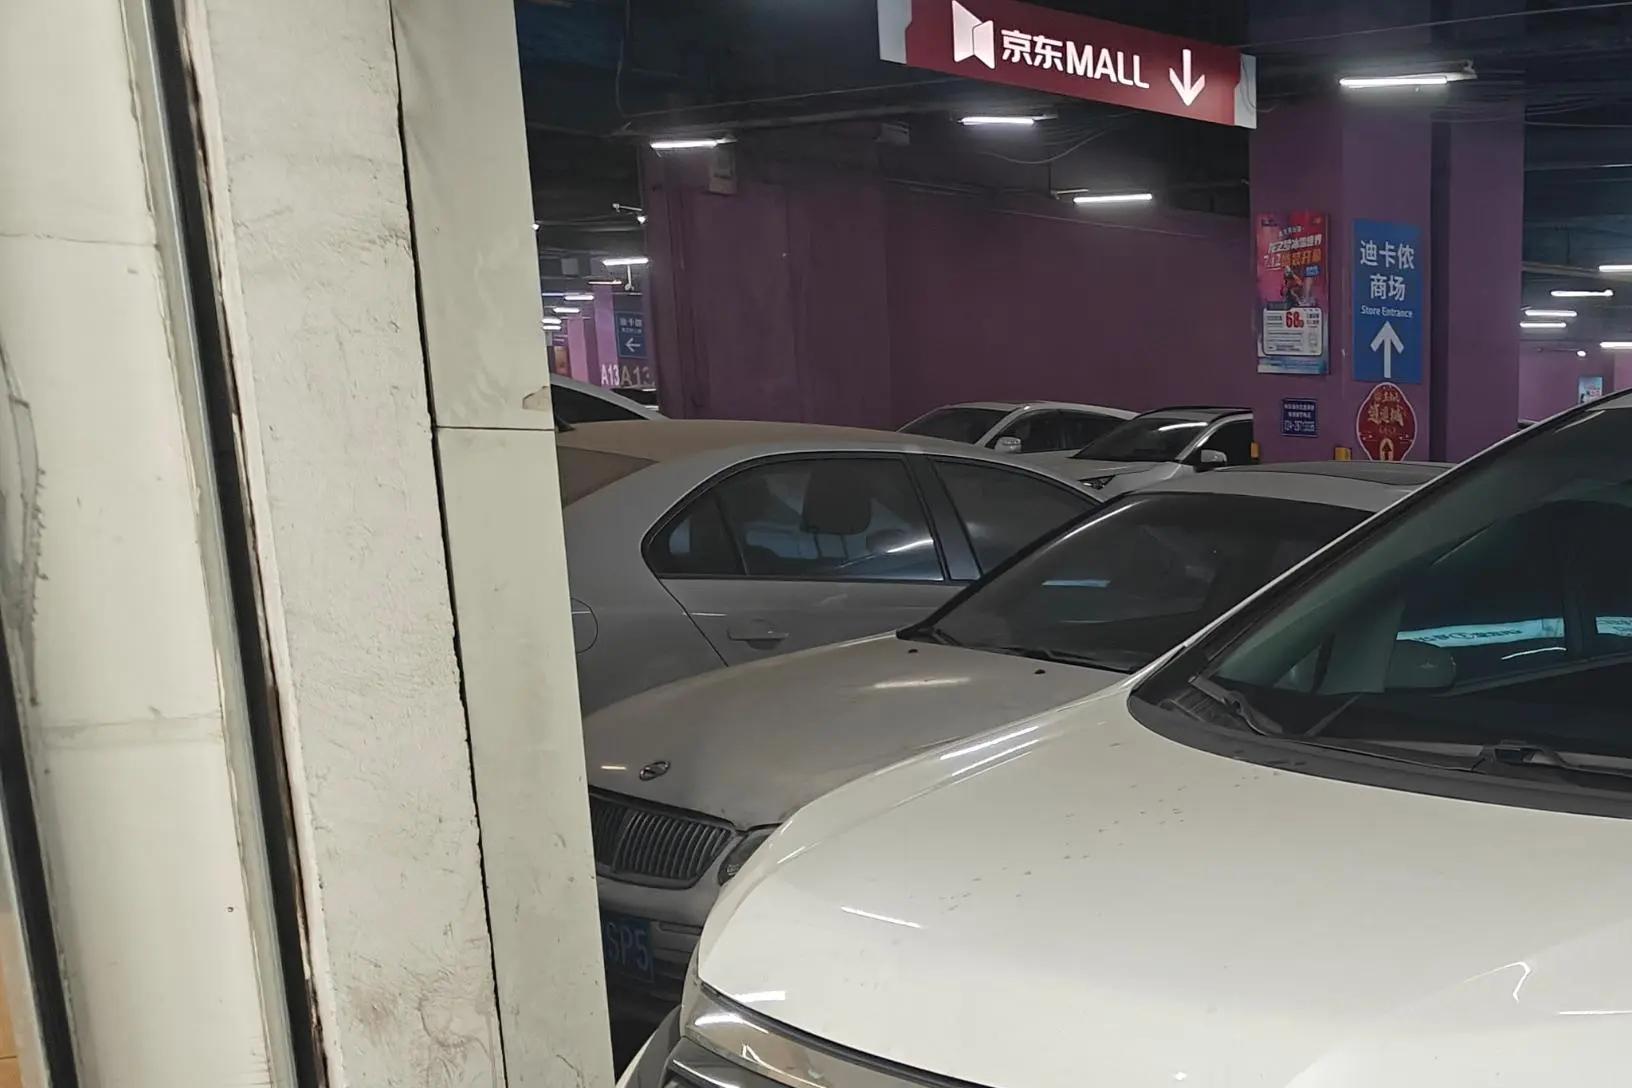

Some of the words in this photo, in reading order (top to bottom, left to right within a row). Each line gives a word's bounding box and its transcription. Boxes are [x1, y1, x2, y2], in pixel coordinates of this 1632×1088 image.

[1001, 29, 1150, 89] 京东MALL
[1360, 240, 1415, 269] 迪卡侬
[1370, 273, 1406, 301] 商场
[1361, 304, 1380, 315] Store
[1381, 306, 1413, 318] Entrance
[601, 364, 620, 386] A13
